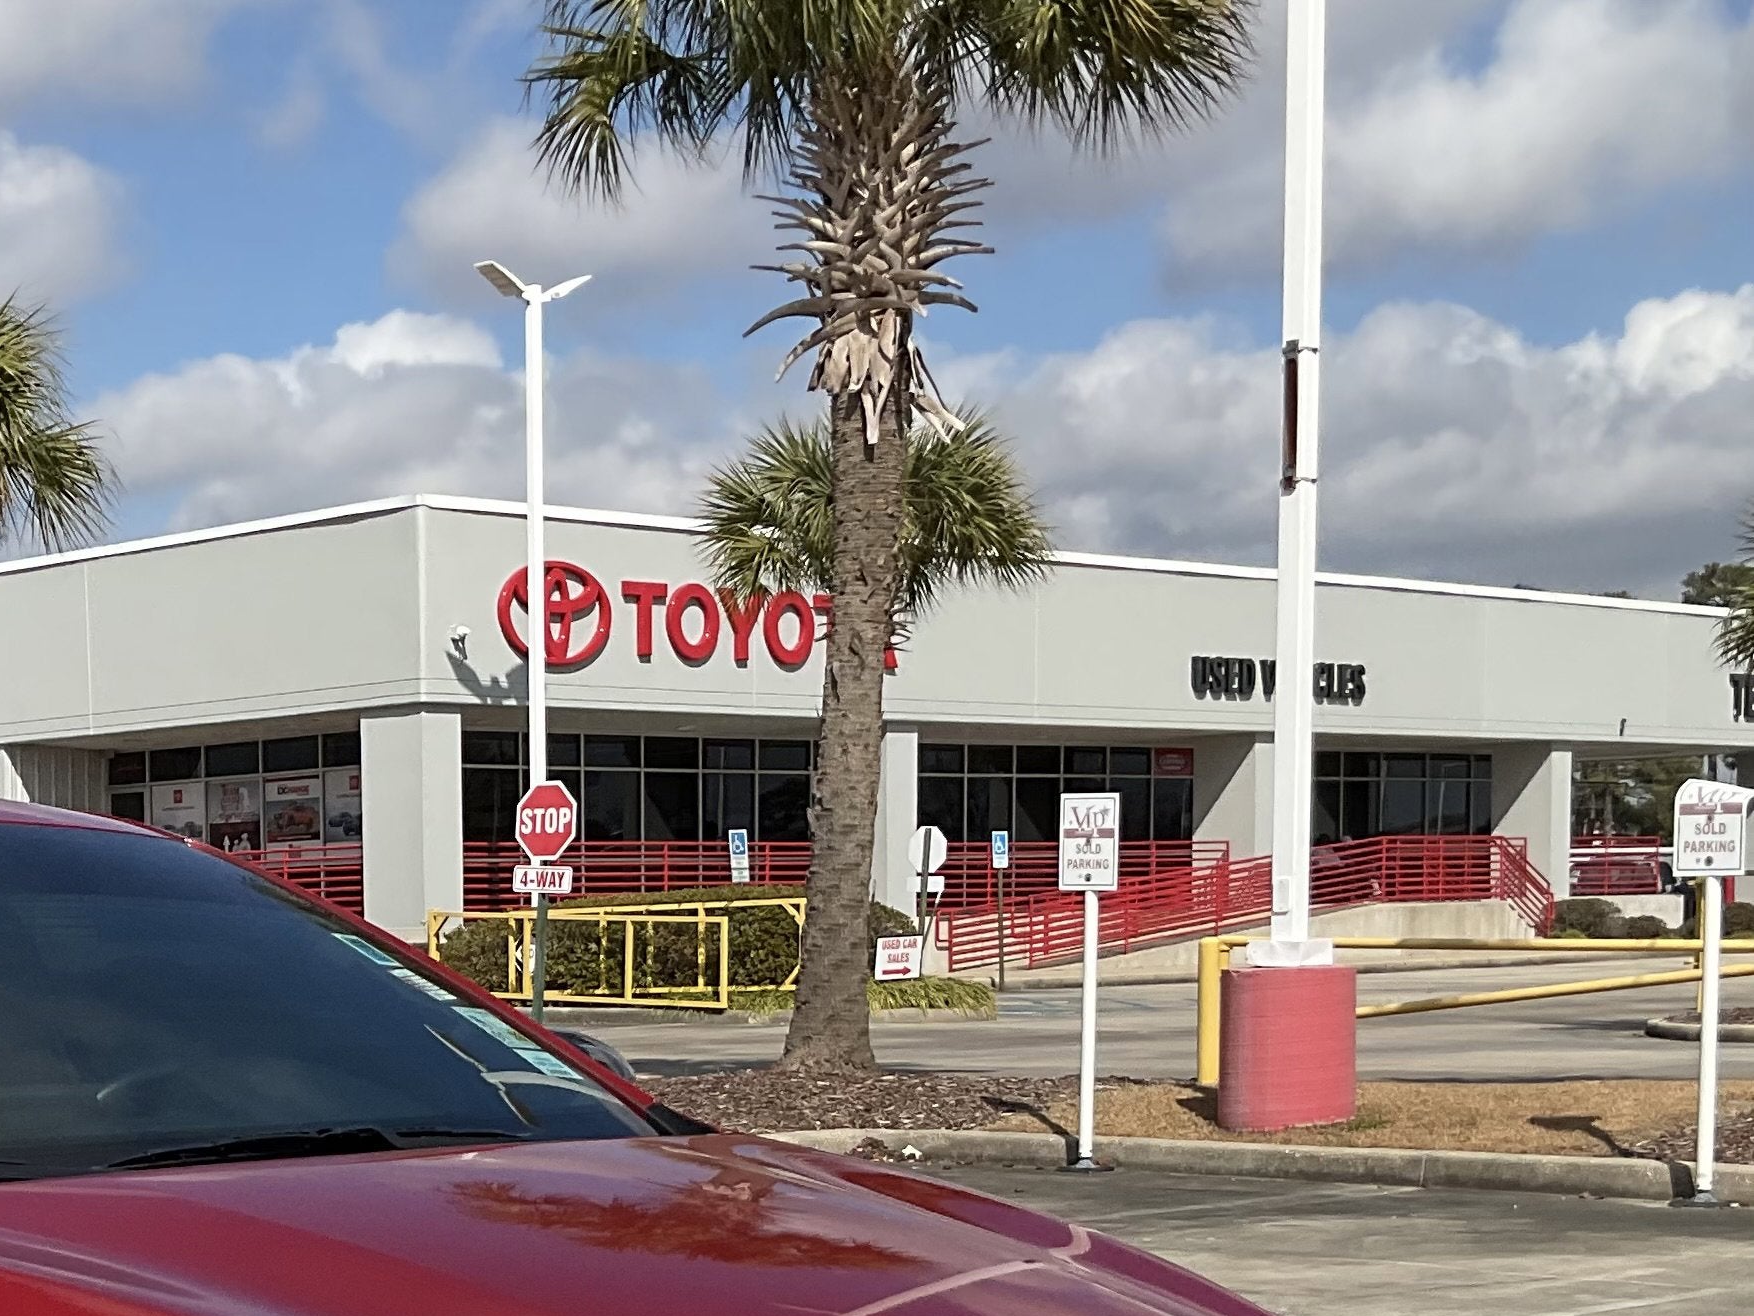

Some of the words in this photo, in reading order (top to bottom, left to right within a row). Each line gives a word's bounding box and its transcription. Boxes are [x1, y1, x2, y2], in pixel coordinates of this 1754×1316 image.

[621, 581, 898, 671] TOYO
[1191, 656, 1256, 700] USED
[1259, 659, 1366, 705] VCLES
[520, 807, 572, 834] STOP
[1694, 822, 1726, 835] SOLD
[1075, 843, 1102, 855] SOLD
[1683, 840, 1736, 853] PARKING
[1066, 858, 1110, 870] PARKING
[519, 870, 566, 889] 4-WAY
[881, 938, 901, 951] USED
[902, 937, 918, 949] CAR
[887, 952, 910, 964] SALES
